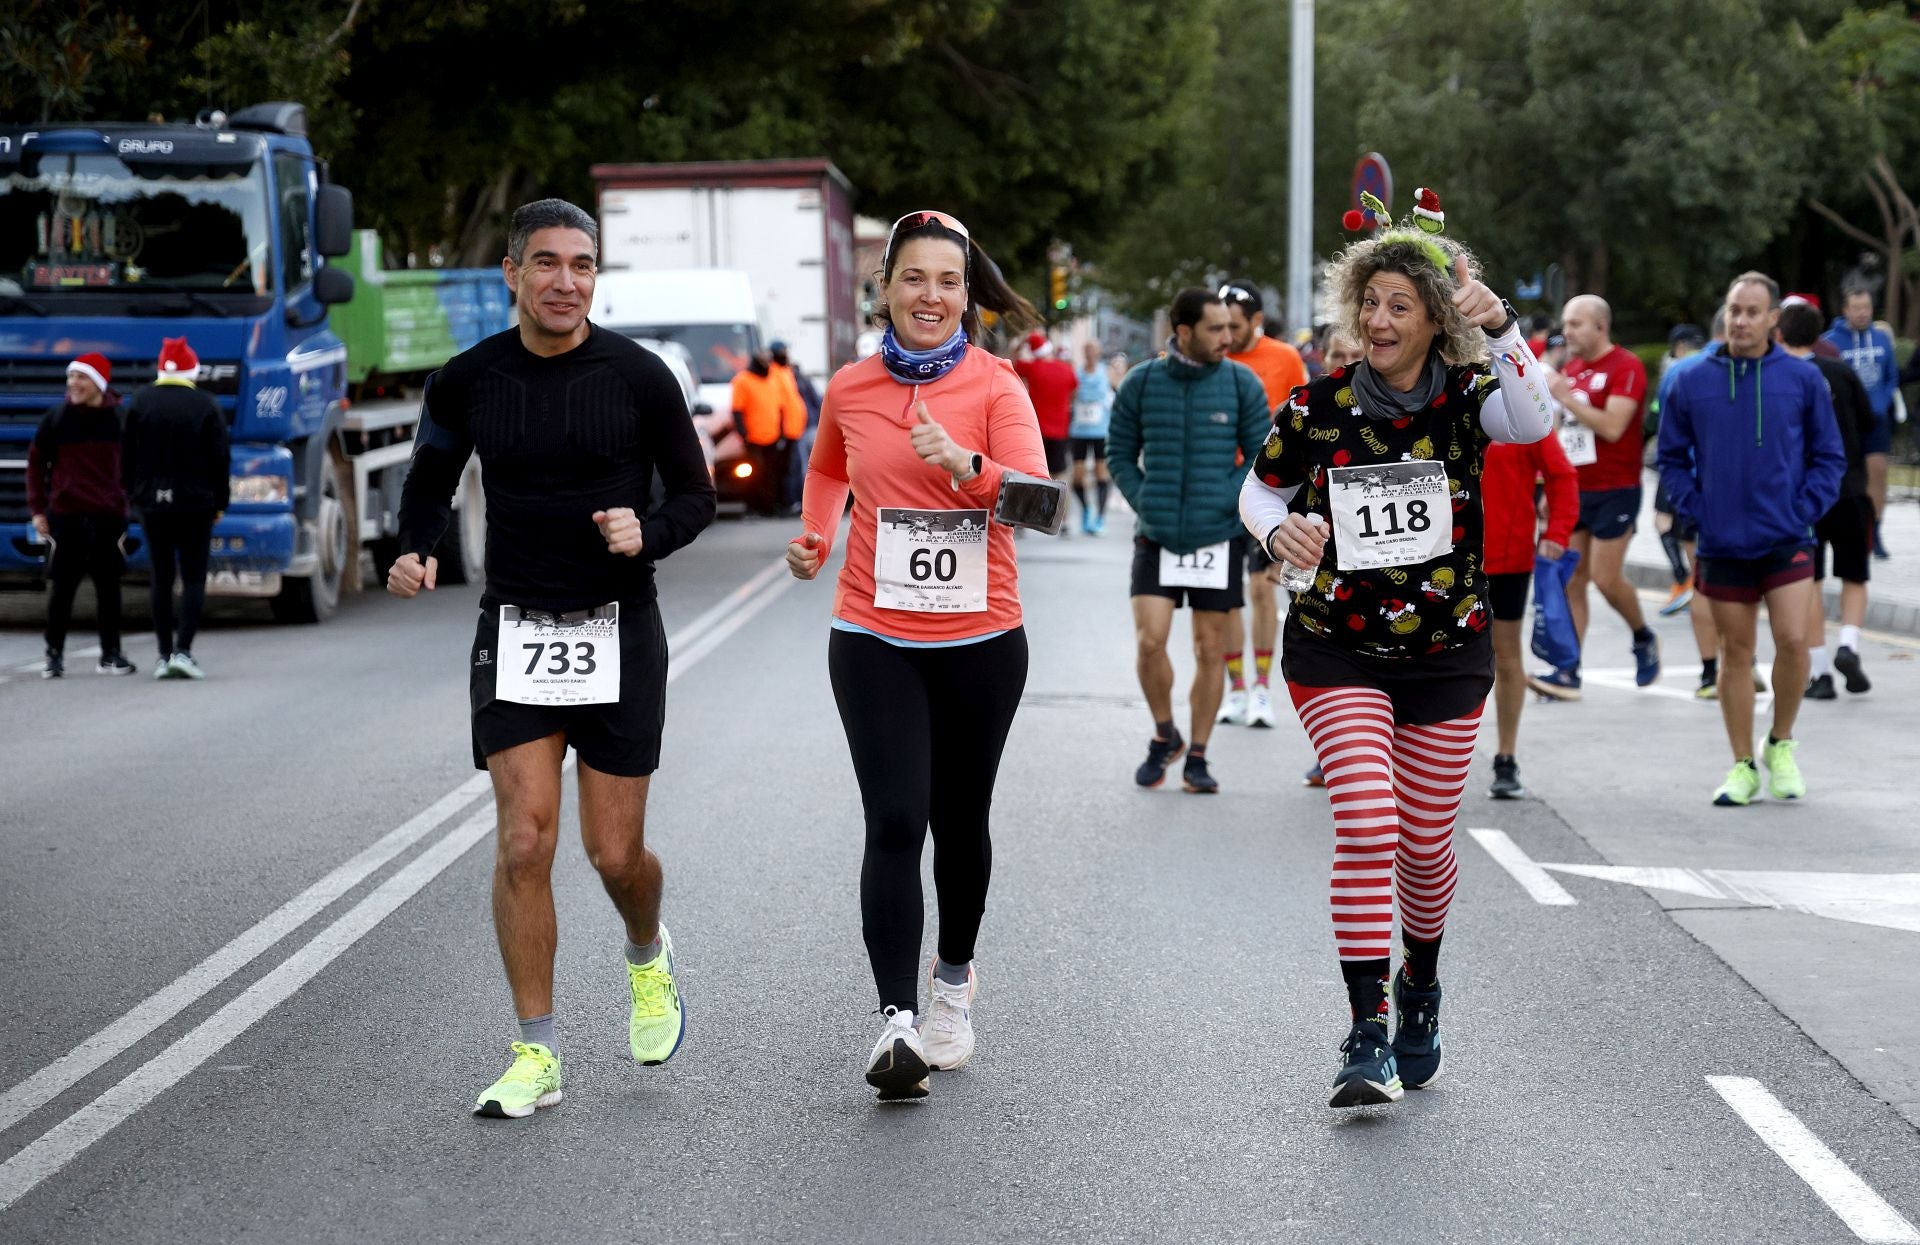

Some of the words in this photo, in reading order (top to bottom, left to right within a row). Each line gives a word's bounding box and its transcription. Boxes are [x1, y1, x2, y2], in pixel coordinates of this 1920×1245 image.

[118, 138, 173, 153] GRUPO
[1359, 425, 1389, 455] GRINCH
[1409, 474, 1443, 483] XIV
[1356, 499, 1431, 538] 118
[909, 548, 957, 582] 60
[1175, 551, 1215, 570] 112
[1299, 591, 1330, 615] GRINCH
[584, 617, 616, 626] XIV
[522, 641, 597, 675] 733
